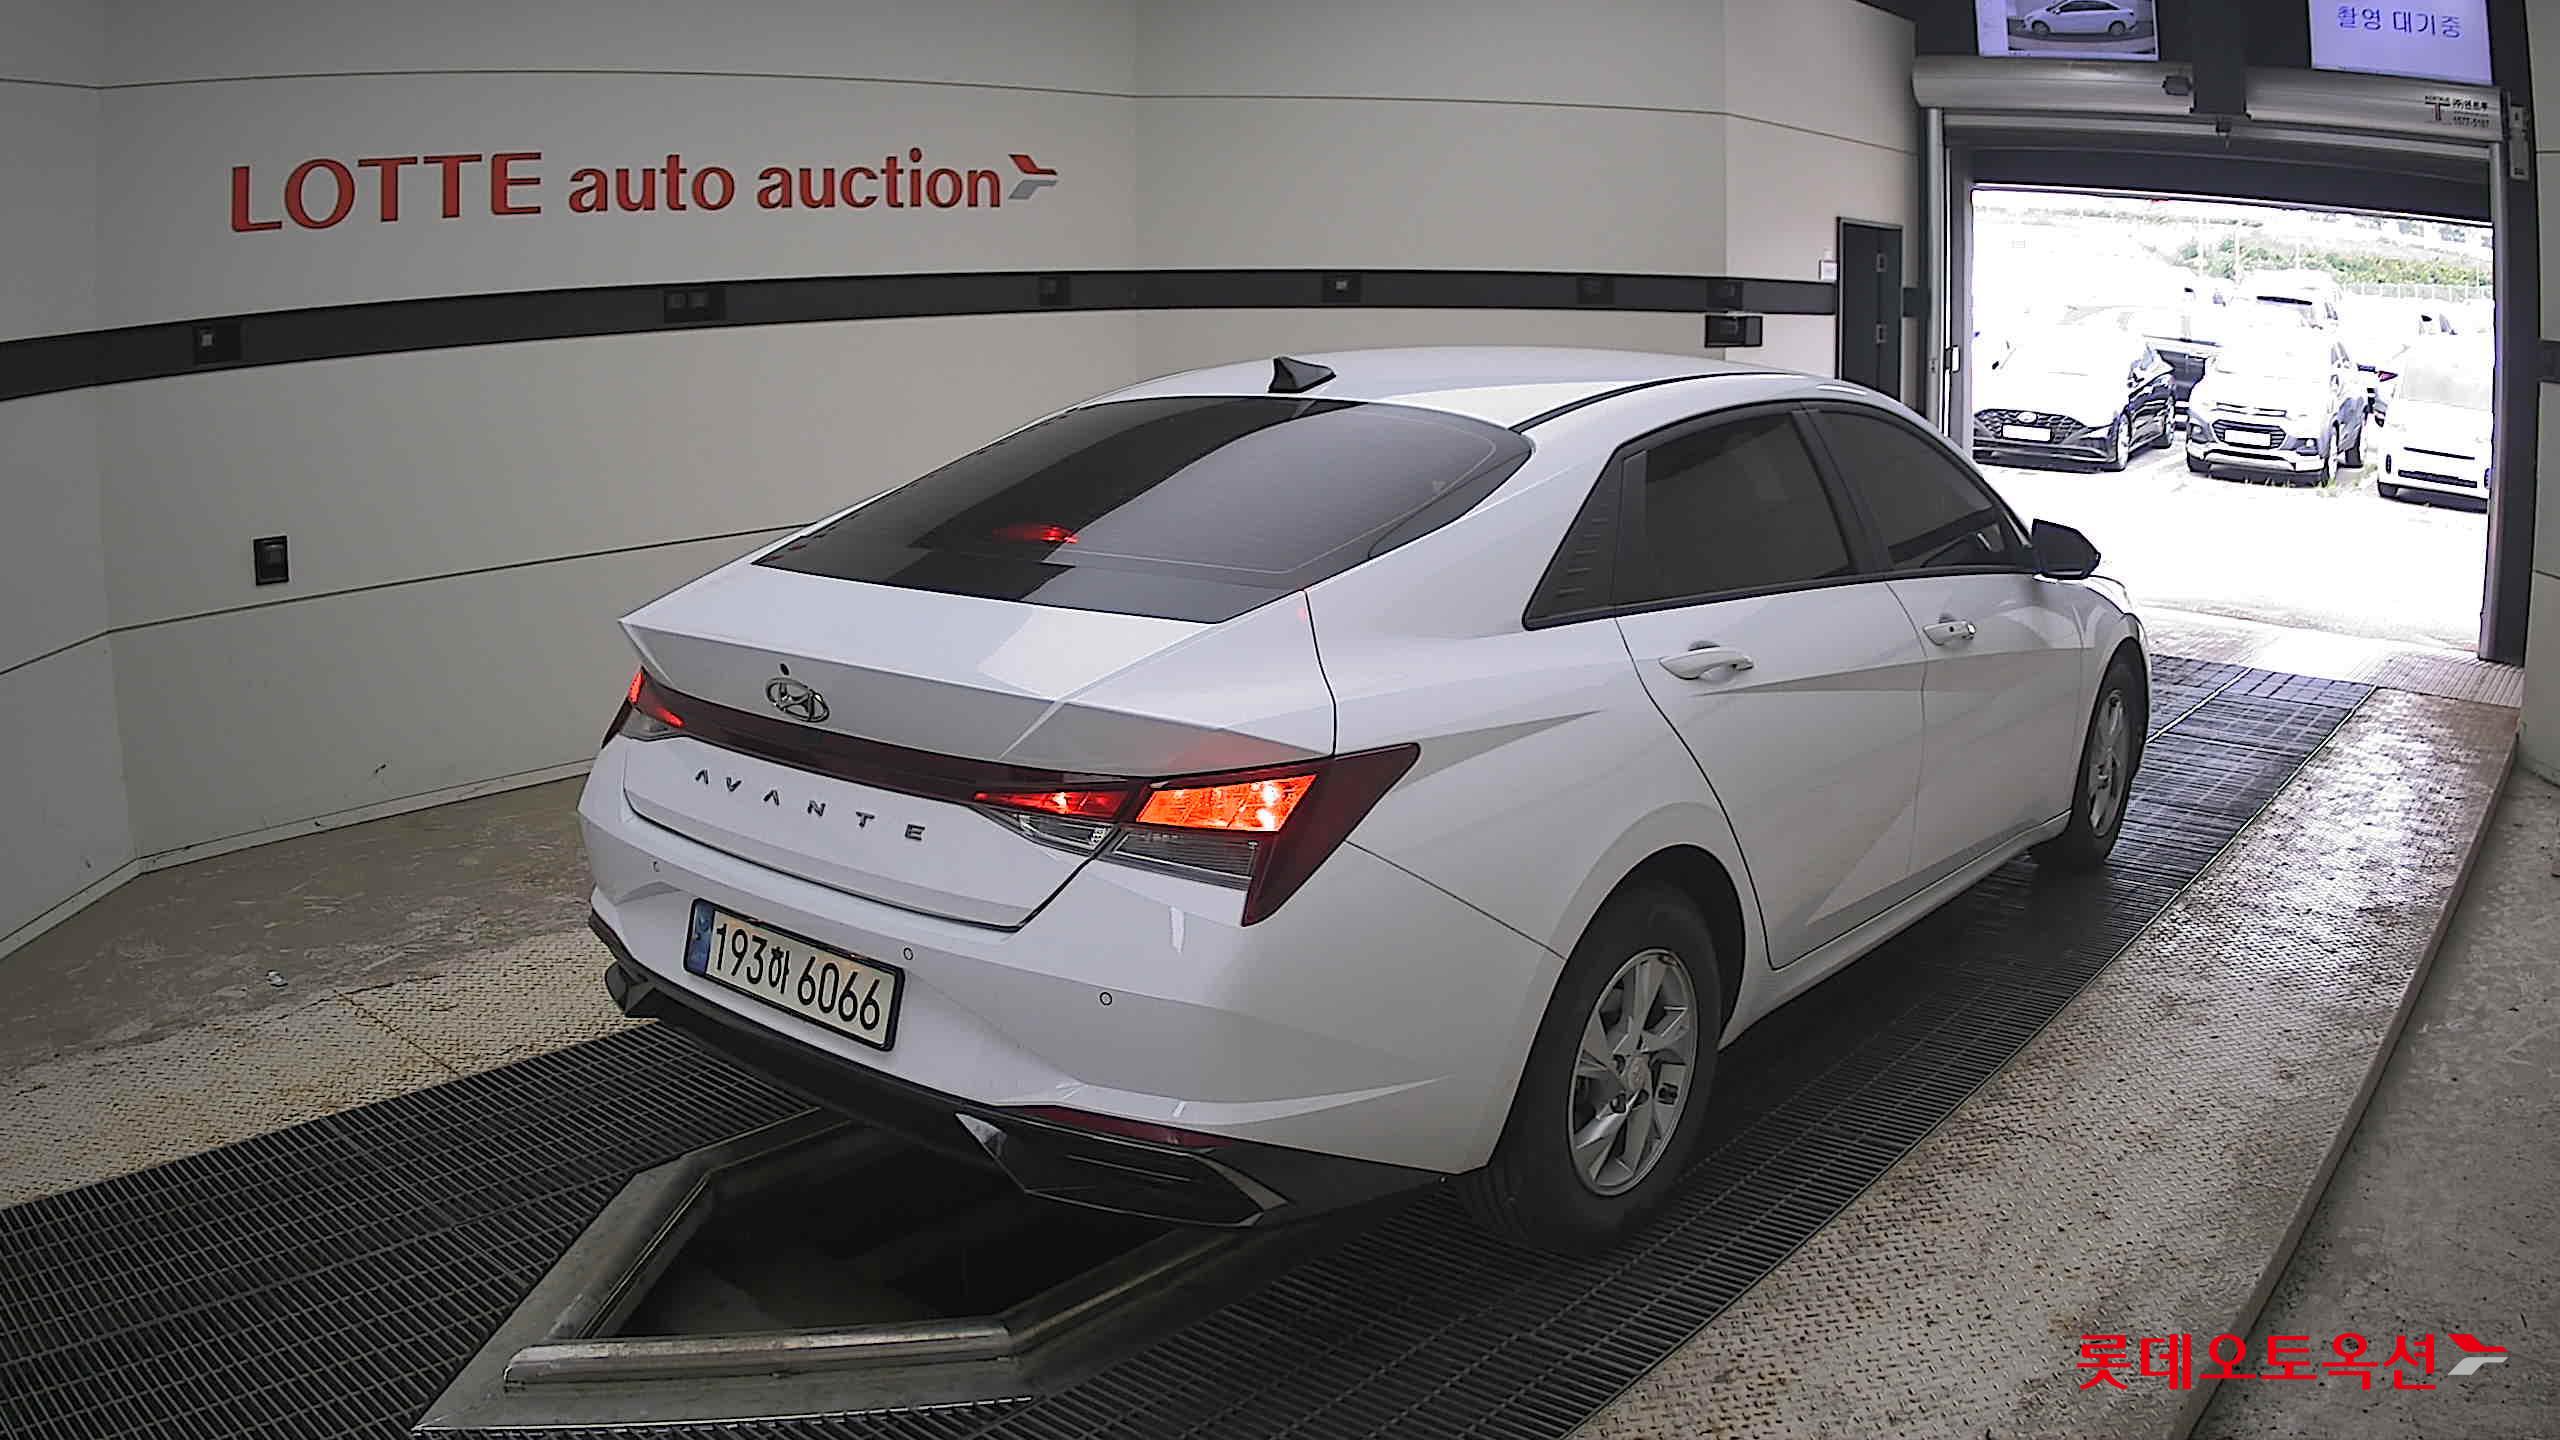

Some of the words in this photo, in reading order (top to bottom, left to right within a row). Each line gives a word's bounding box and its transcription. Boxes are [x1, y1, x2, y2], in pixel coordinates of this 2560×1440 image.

[2337, 5, 2382, 31] 촬영
[2392, 11, 2462, 39] 대기중
[231, 151, 543, 233] LOTTE
[568, 153, 736, 215] auto
[756, 147, 1002, 210] auction
[694, 768, 926, 842] AVANTE
[714, 922, 791, 996] 193하
[797, 955, 881, 1032] 6066
